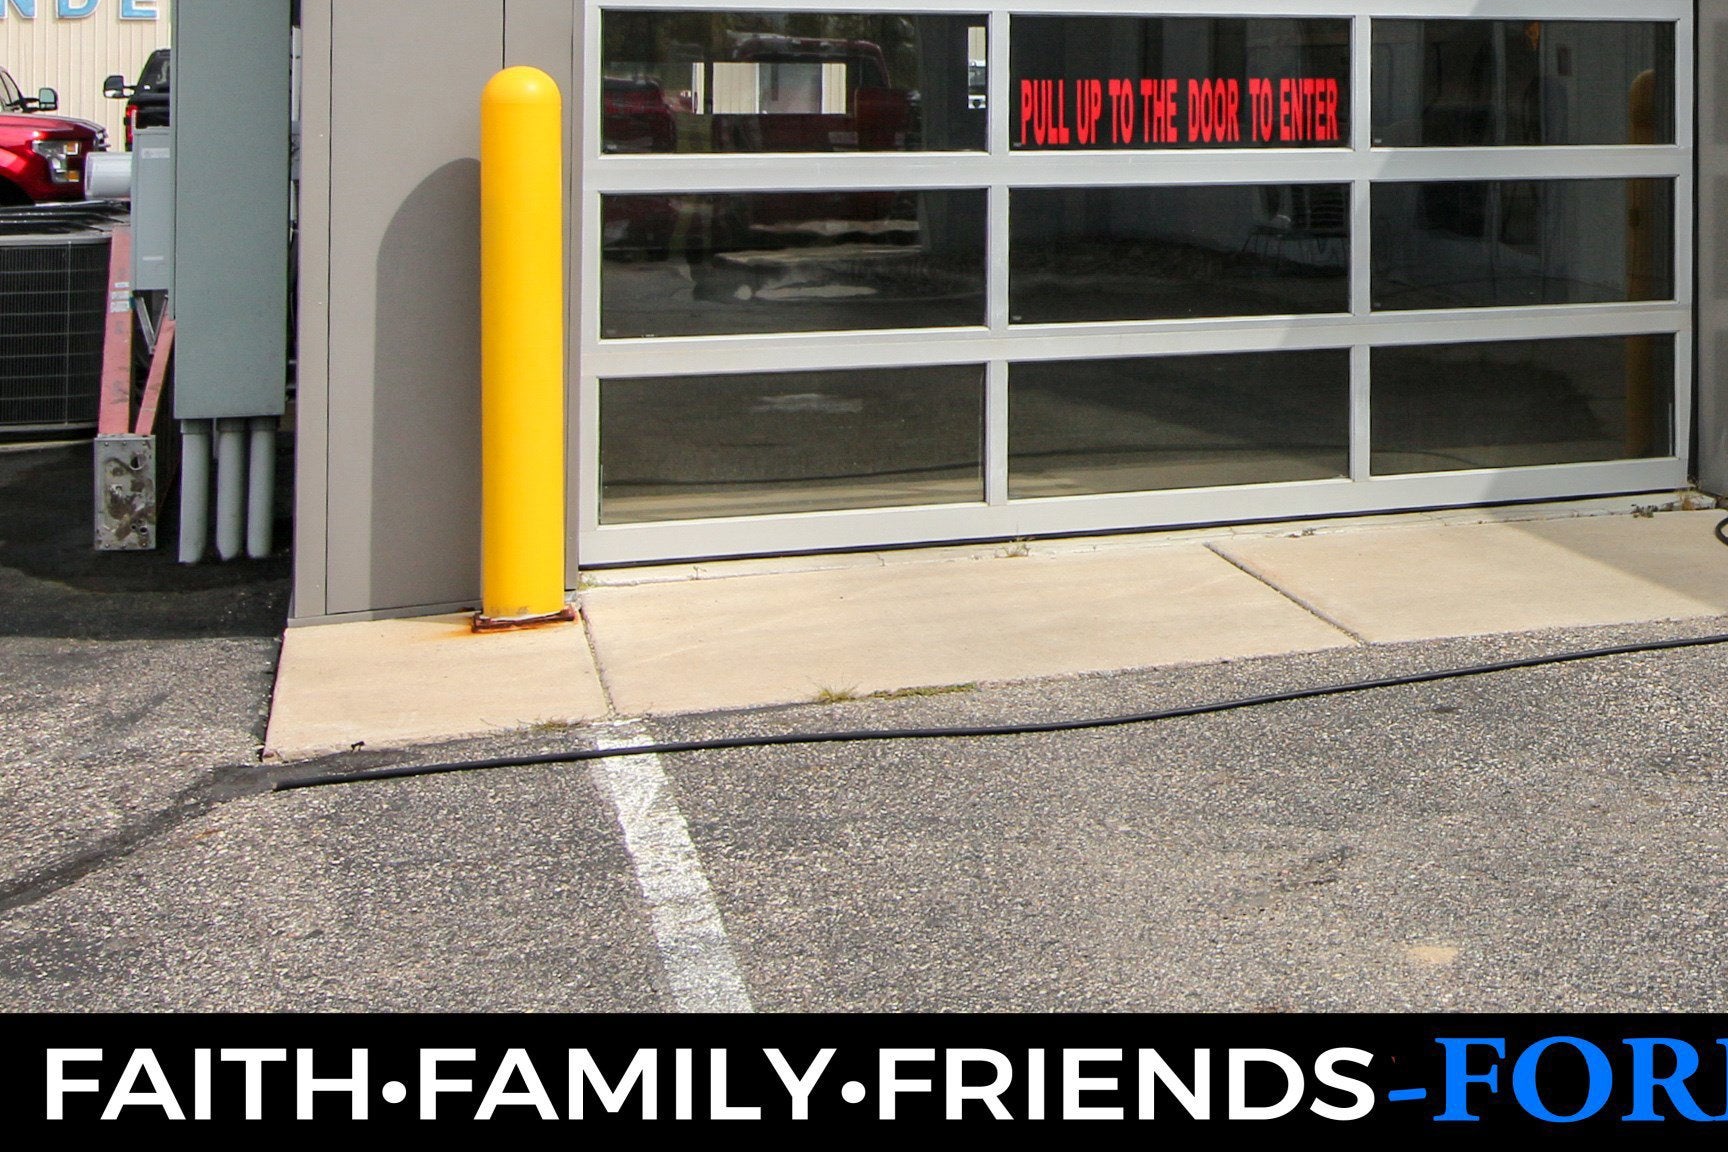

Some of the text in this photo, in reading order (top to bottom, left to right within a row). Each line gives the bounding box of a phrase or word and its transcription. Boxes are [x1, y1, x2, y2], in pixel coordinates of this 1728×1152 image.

[1021, 78, 1338, 145] PULL UP TO THE DOOR TO ENTER
